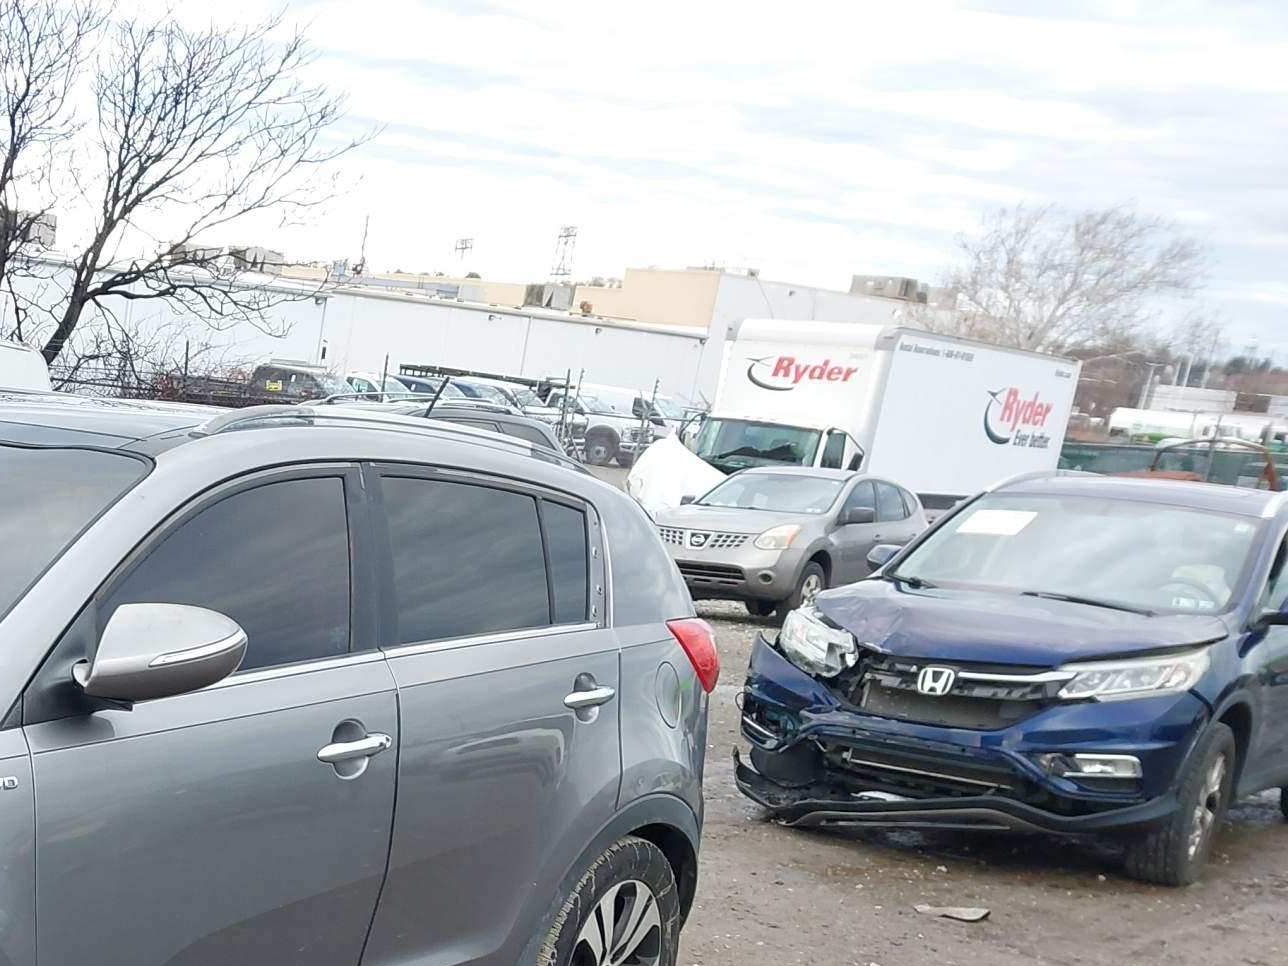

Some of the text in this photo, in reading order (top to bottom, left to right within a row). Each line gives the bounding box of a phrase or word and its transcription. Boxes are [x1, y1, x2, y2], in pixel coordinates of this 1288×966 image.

[772, 356, 858, 384] Ryder
[1000, 388, 1053, 432] Ryder
[1013, 428, 1030, 447] Ever
